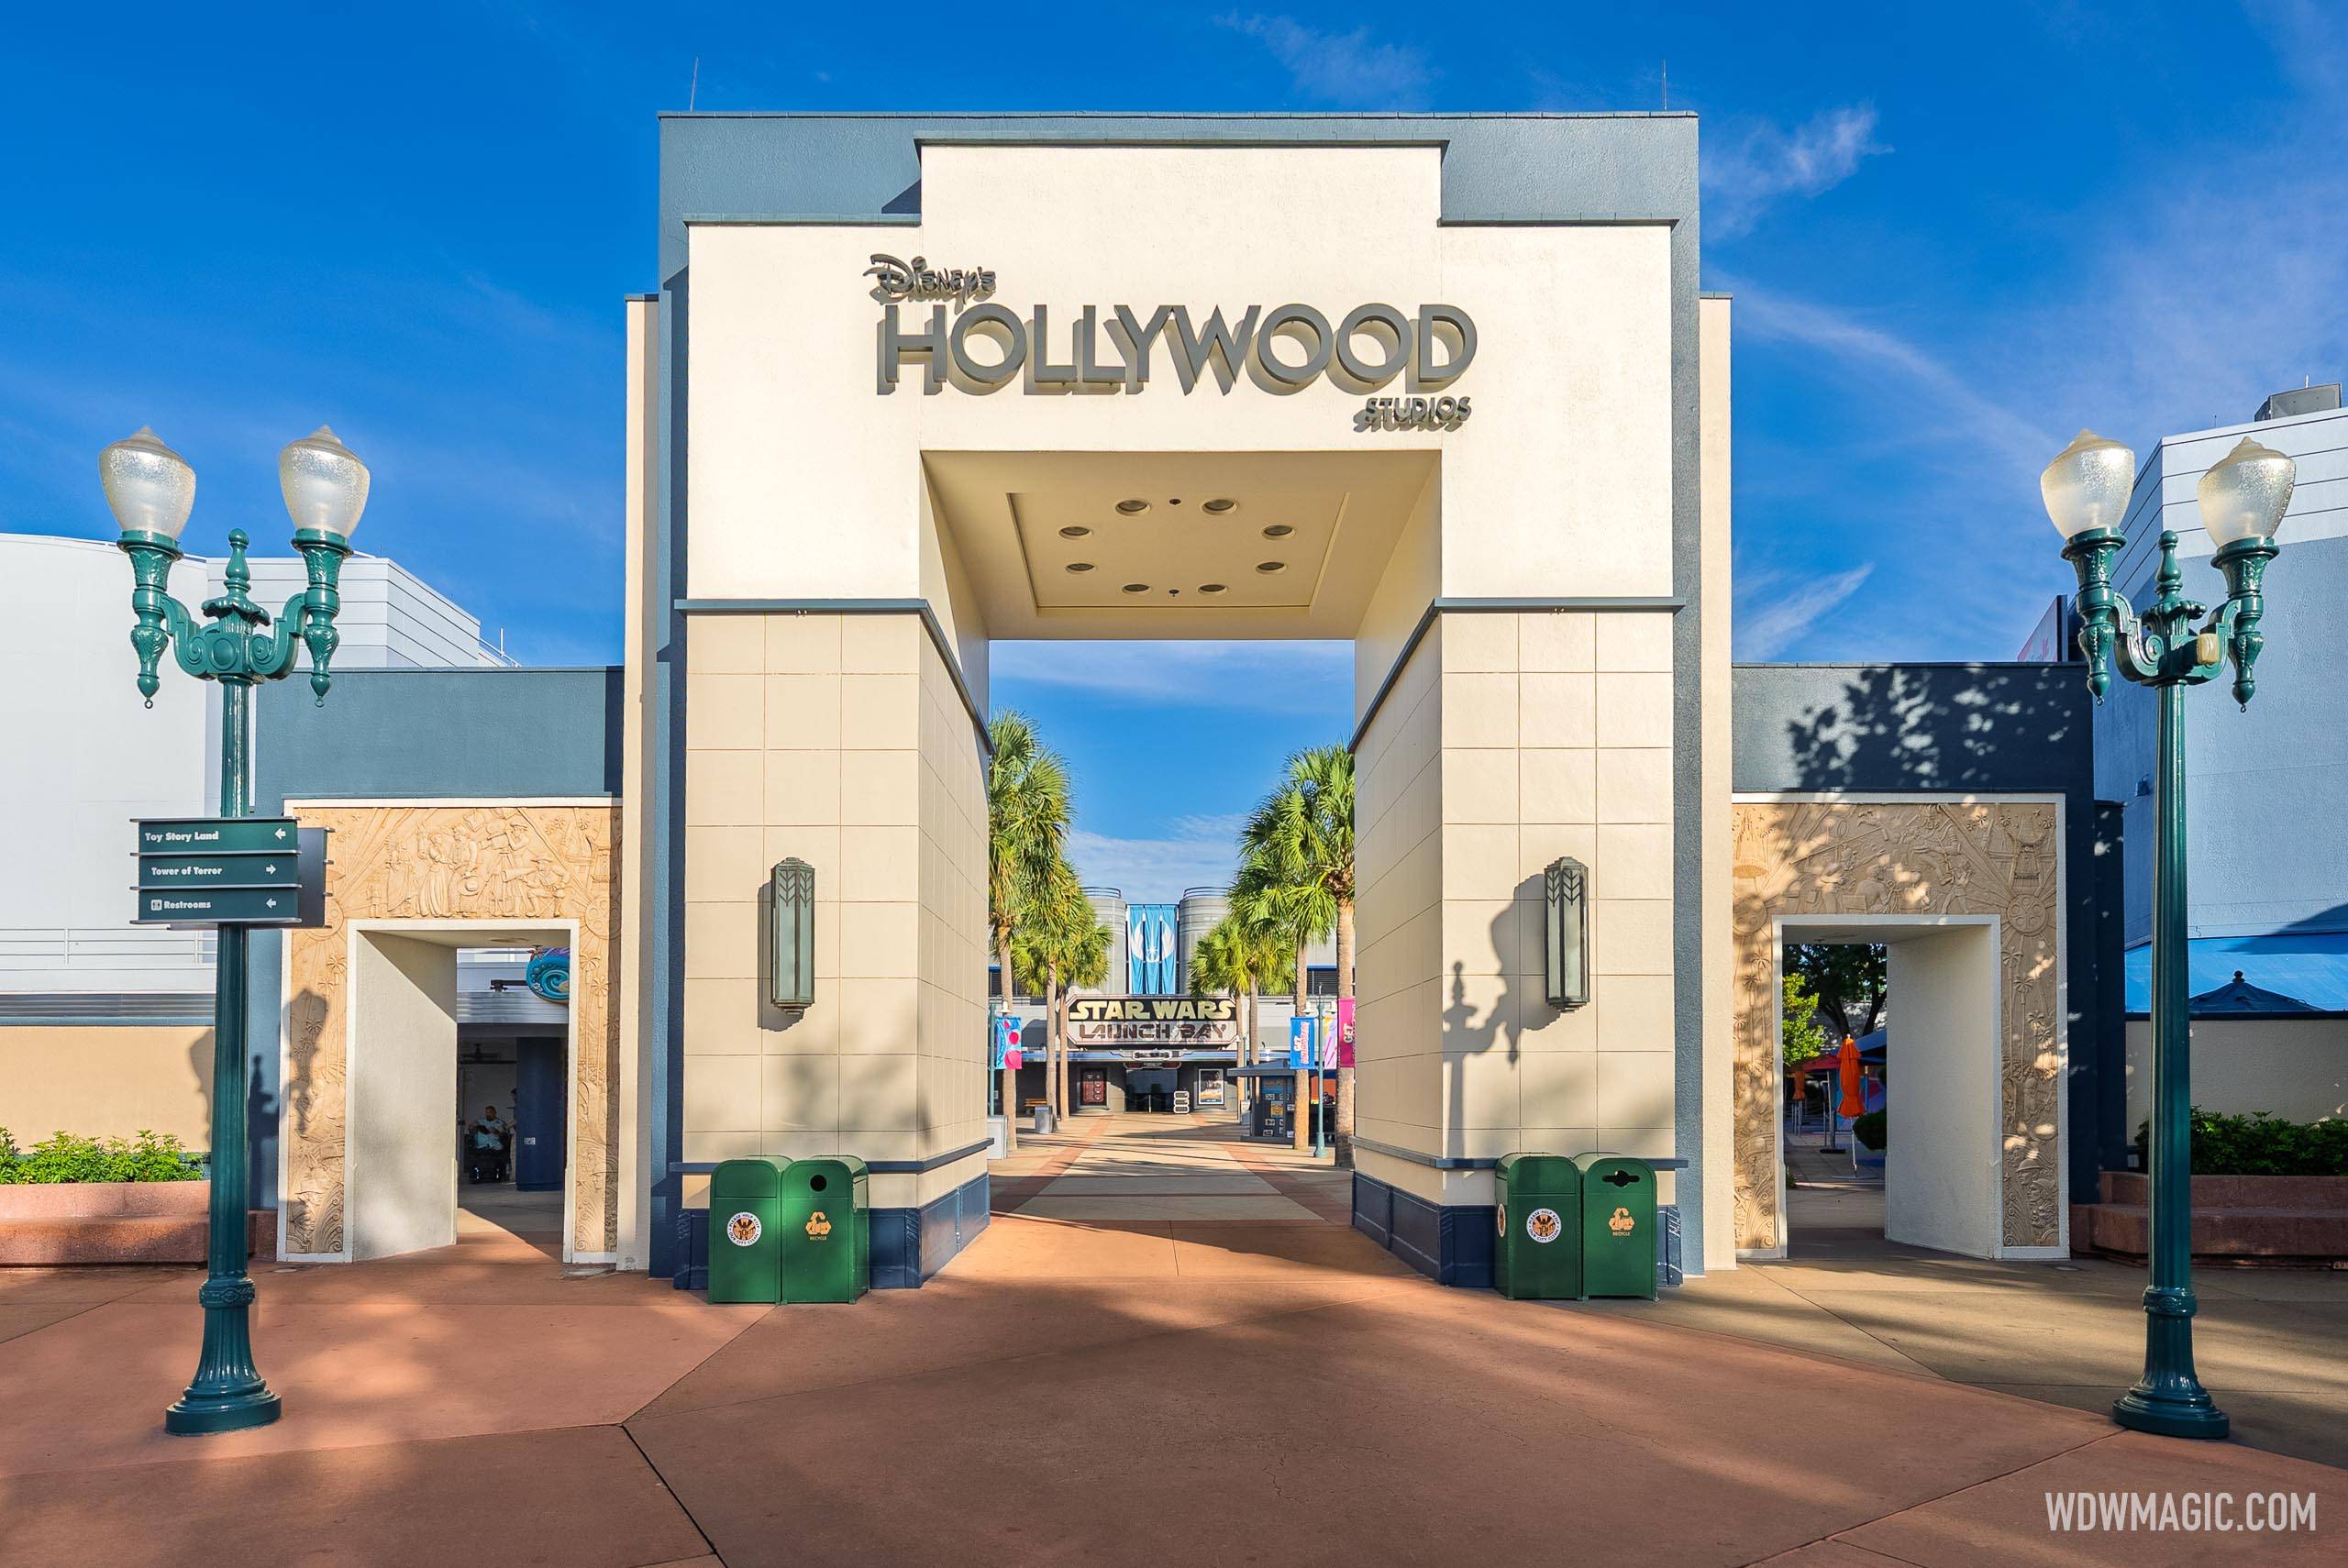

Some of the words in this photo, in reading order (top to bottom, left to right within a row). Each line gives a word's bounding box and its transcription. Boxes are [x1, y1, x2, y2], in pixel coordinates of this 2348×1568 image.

[882, 304, 1478, 389] HOLLYWOOD
[1364, 396, 1472, 423] STUDIOS
[145, 833, 163, 843] Toy
[165, 832, 192, 843] Story
[194, 831, 219, 841] Land
[151, 867, 180, 876] Tower
[181, 866, 192, 876] of
[193, 866, 223, 875] Terror
[163, 900, 212, 910] Restrooms
[1069, 1000, 1151, 1021] STAR
[1152, 1000, 1237, 1020] WARS
[1079, 1023, 1170, 1039] LAUNCH
[1180, 1024, 1227, 1039] BAY
